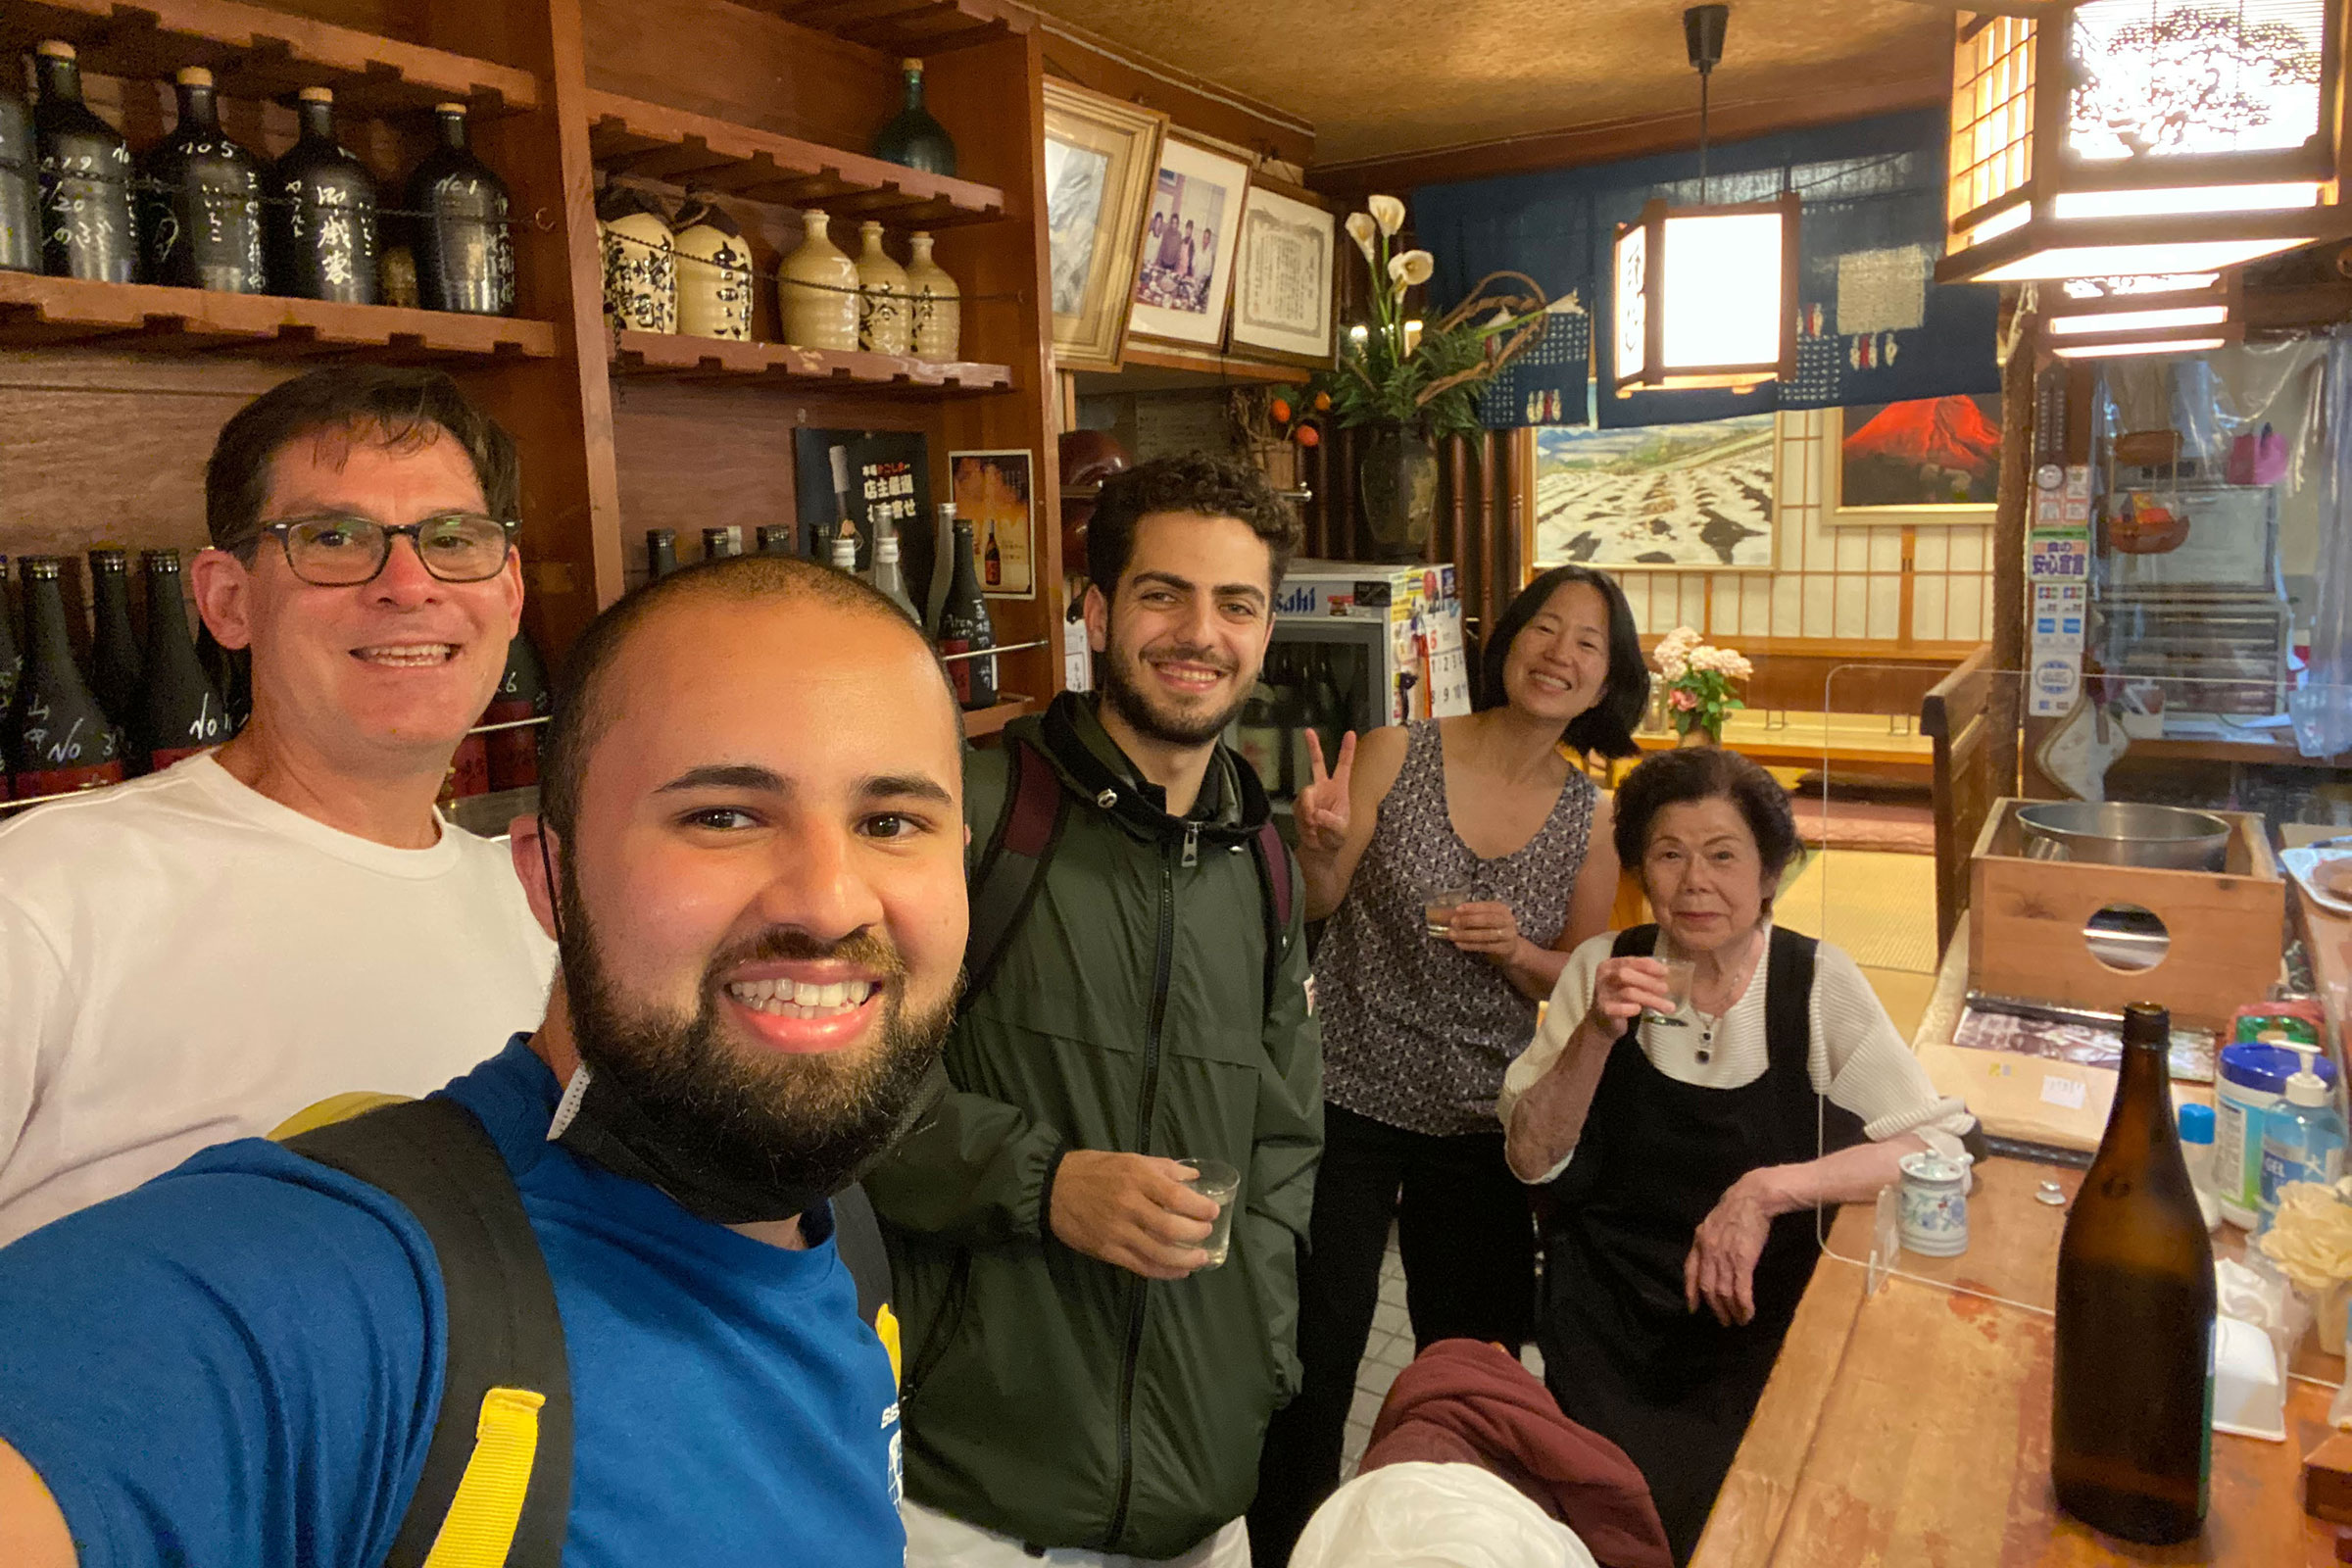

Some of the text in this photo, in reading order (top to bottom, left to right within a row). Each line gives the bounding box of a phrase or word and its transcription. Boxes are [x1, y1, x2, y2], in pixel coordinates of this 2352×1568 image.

[1275, 586, 1316, 612] sahi
[189, 692, 218, 740] No
[48, 717, 83, 762] No
